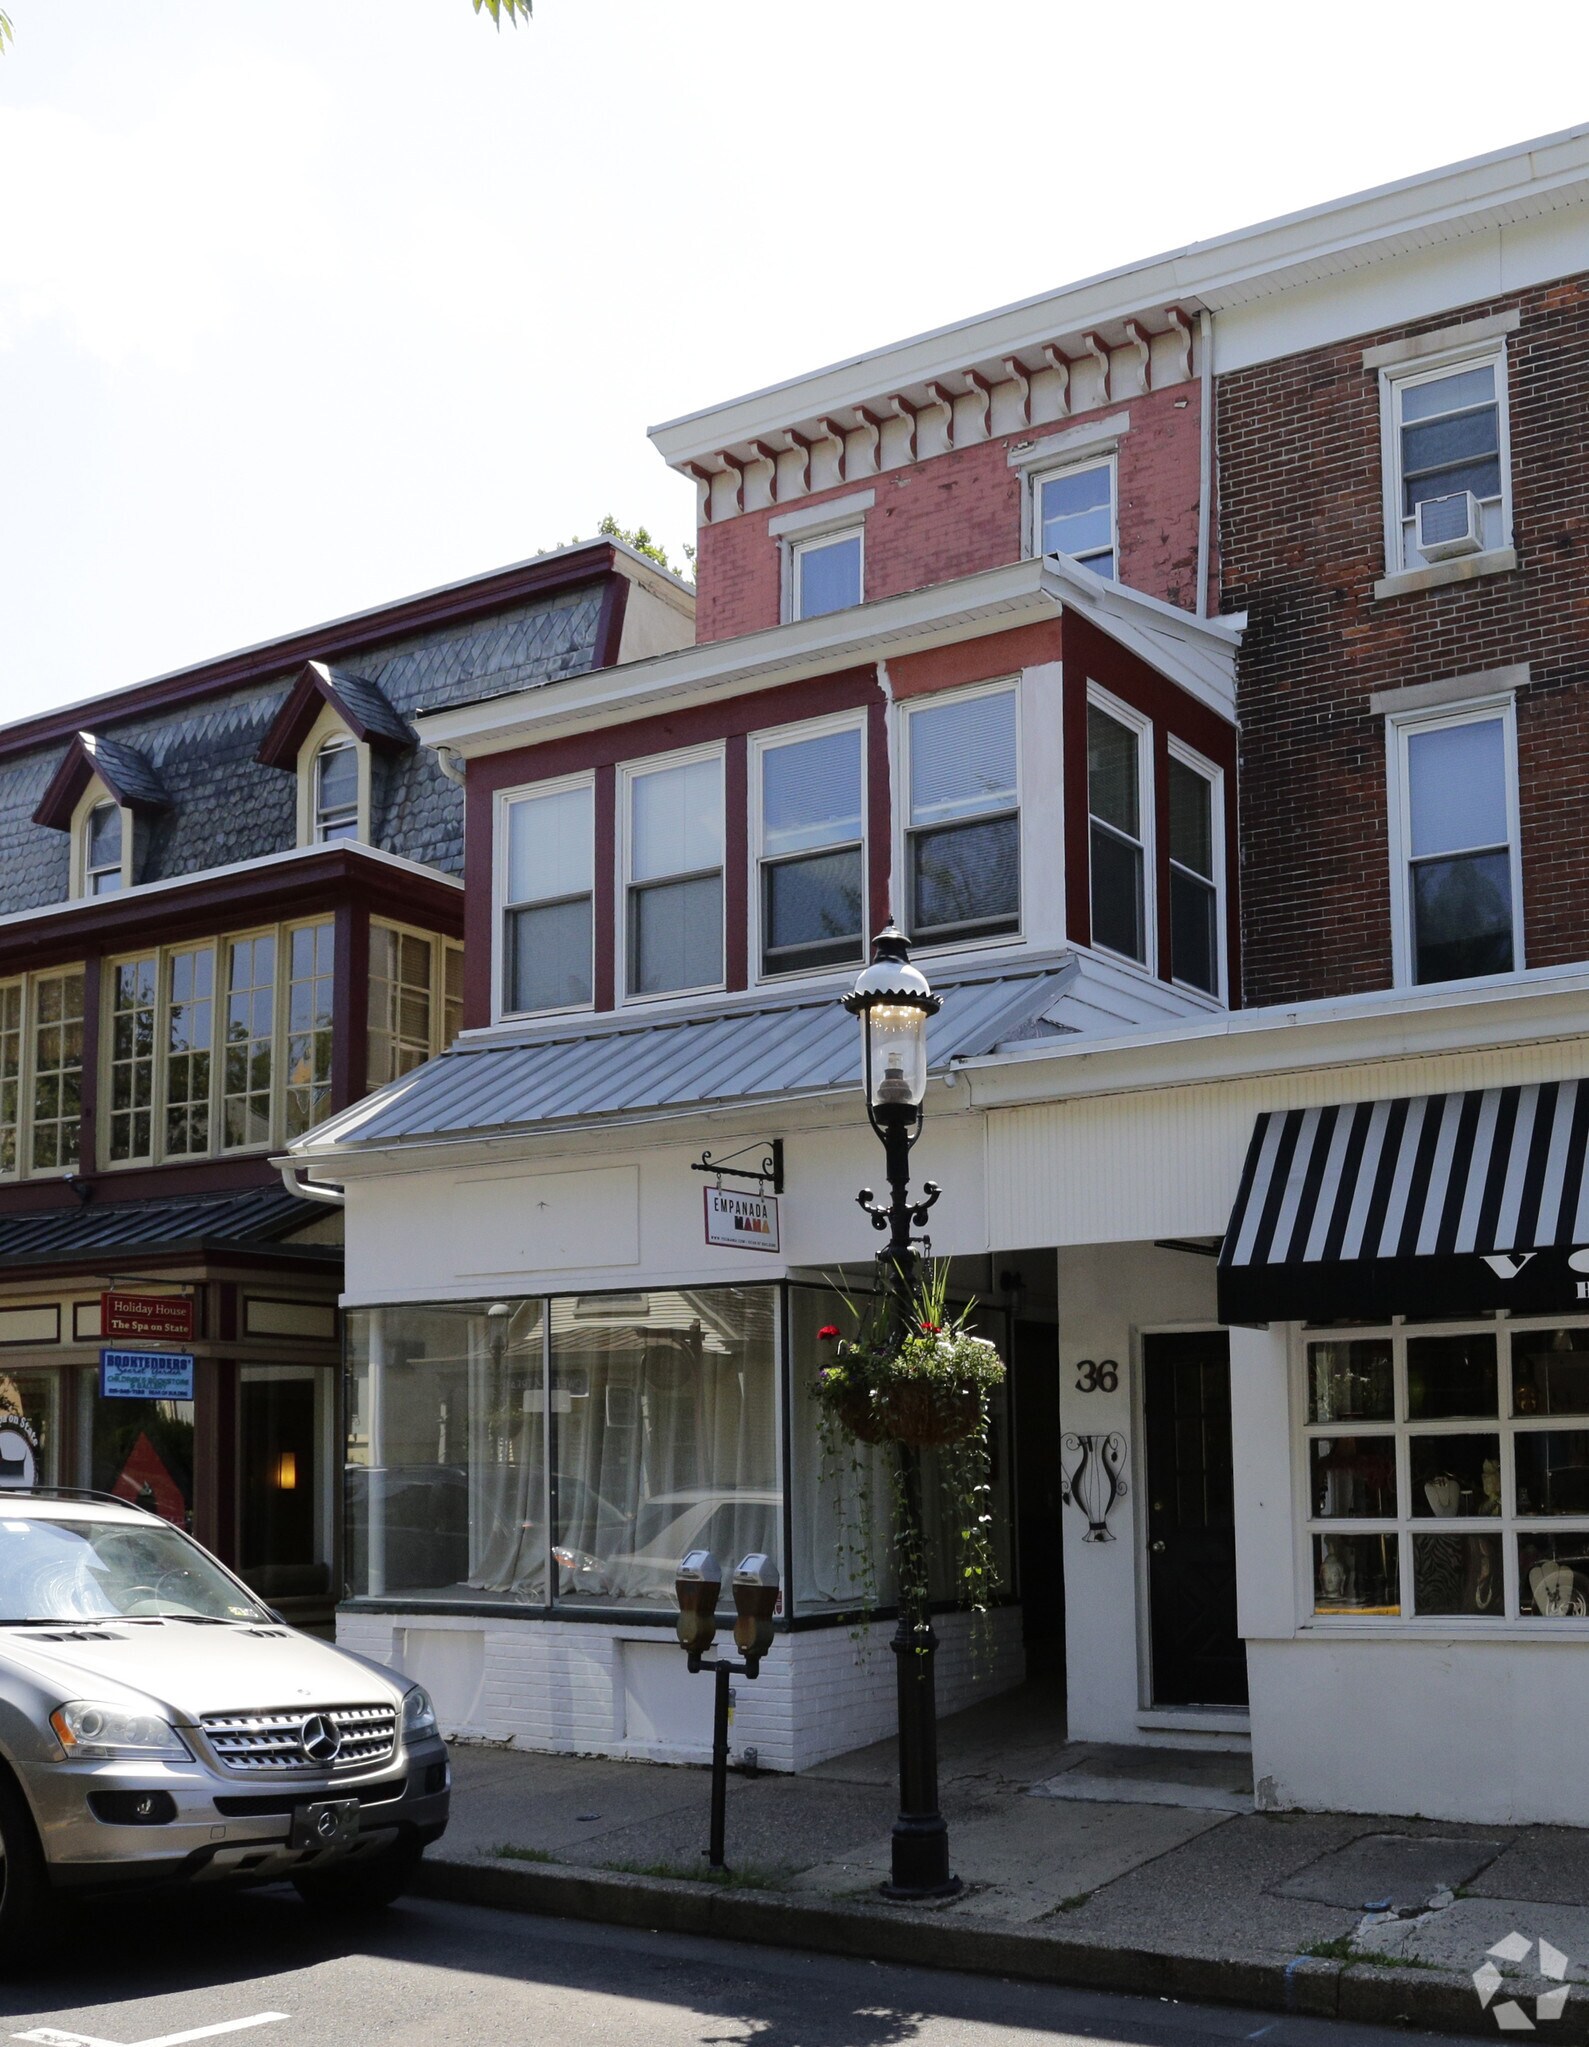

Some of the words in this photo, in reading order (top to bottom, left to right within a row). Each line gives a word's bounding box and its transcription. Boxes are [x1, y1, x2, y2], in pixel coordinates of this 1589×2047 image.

[714, 1197, 768, 1219] EMPANADA
[734, 1215, 770, 1234] MAMA
[114, 1301, 153, 1316] Holiday
[155, 1304, 186, 1316] House
[111, 1319, 130, 1329] The
[132, 1321, 149, 1332] Spa
[164, 1323, 188, 1332] State
[107, 1355, 191, 1370] BOOKTENDERS'
[1075, 1360, 1119, 1393] 36
[9, 1415, 18, 1424] on
[20, 1417, 38, 1446] State
